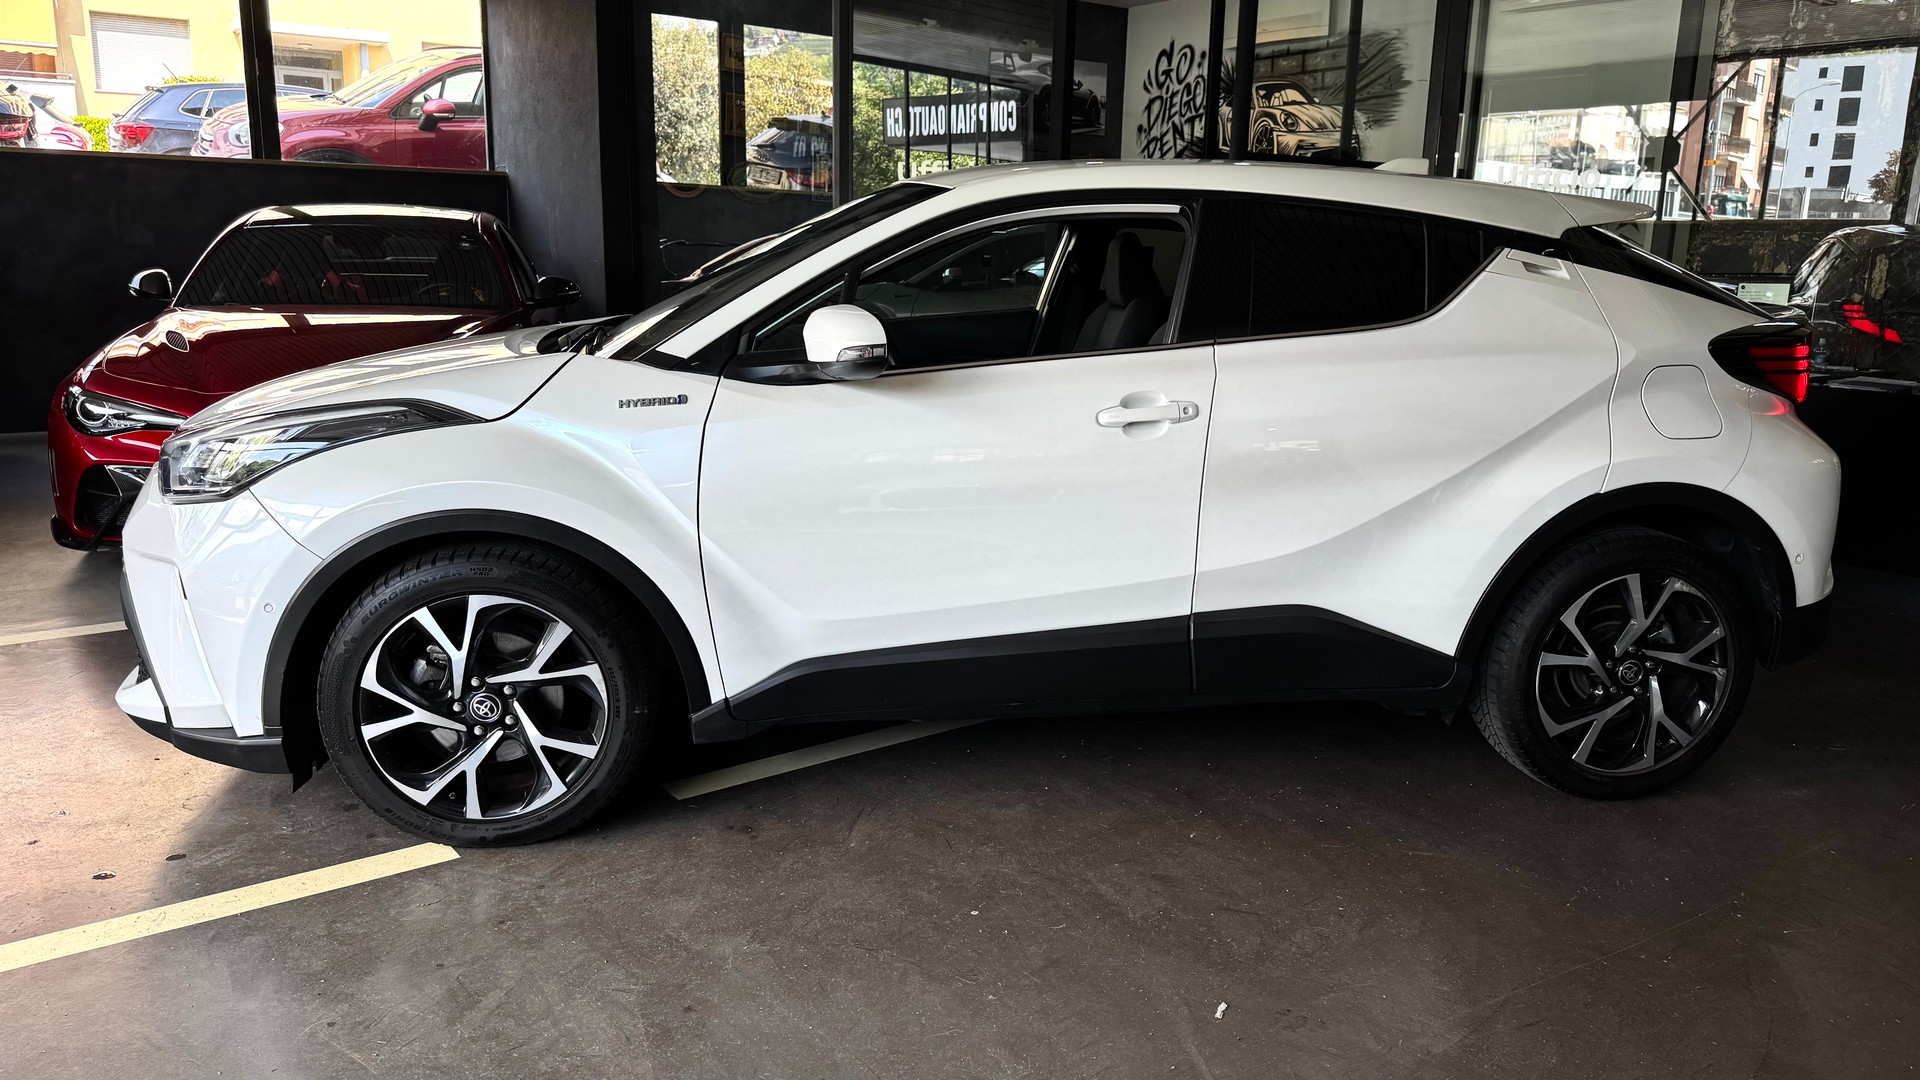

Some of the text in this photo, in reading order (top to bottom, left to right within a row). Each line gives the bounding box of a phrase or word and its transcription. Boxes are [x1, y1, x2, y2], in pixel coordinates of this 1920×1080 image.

[1155, 39, 1196, 90] GO
[1142, 75, 1206, 138] DIEGO
[618, 396, 677, 408] HYBRID
[360, 568, 464, 626] EUROWINTER
